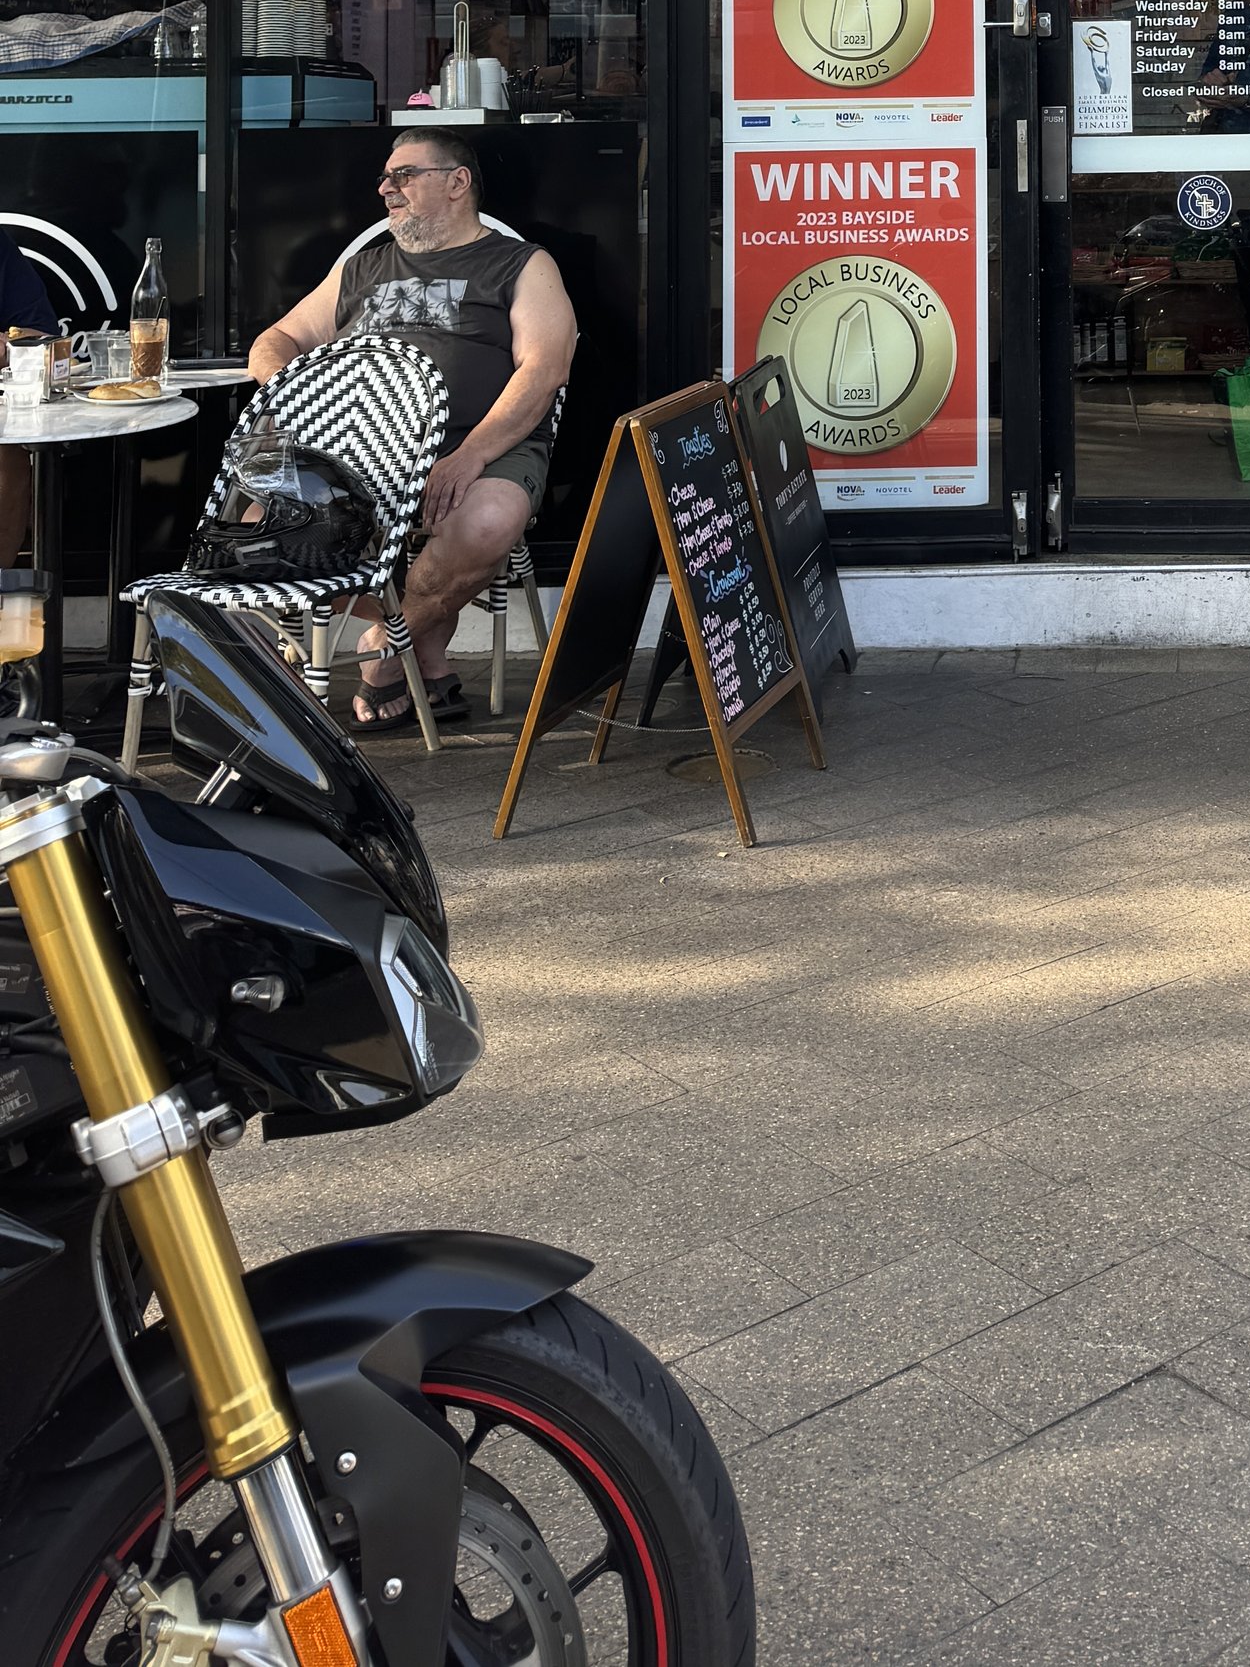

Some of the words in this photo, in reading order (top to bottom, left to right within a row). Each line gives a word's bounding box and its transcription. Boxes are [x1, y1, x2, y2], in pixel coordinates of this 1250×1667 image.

[1136, 0, 1208, 13] Wednesday
[1218, 0, 1244, 9] 8am
[1136, 15, 1198, 28] Thursday
[1218, 14, 1245, 25] 8am
[843, 35, 866, 45] 2023
[1136, 30, 1177, 43] Friday
[1218, 29, 1245, 40] 8am
[1136, 45, 1195, 58] Saturday
[1219, 44, 1245, 55] 8am
[813, 58, 890, 82] AWARDS
[1136, 61, 1186, 74] Sunday
[1219, 59, 1246, 70] 8am
[1142, 86, 1183, 97] Closed
[1188, 85, 1225, 96] Public
[931, 113, 963, 122] Leader
[1079, 121, 1128, 129] FINALIST
[750, 161, 961, 201] WINNER
[1188, 179, 1217, 189] TOUCH
[1216, 185, 1226, 195] OF
[797, 212, 837, 226] 2023
[842, 210, 915, 225] BAYSIDE
[1184, 210, 1226, 226] KINDNESS
[742, 231, 800, 246] LOCAL
[804, 230, 889, 245] BUSINESS
[894, 228, 969, 243] AWARDS
[772, 269, 835, 326] LOCAL
[840, 263, 936, 320] BUSINESS
[843, 388, 871, 400] 2023
[805, 418, 901, 447] AWARDS
[678, 426, 712, 457] Toasties
[670, 483, 697, 506] Cheese
[933, 485, 966, 495] Leader
[676, 509, 692, 531] Ham
[696, 496, 716, 517] Cheese
[689, 551, 709, 577] Cheese
[703, 611, 722, 634] Plain
[708, 636, 722, 653] Ham
[724, 696, 745, 723] Danish
